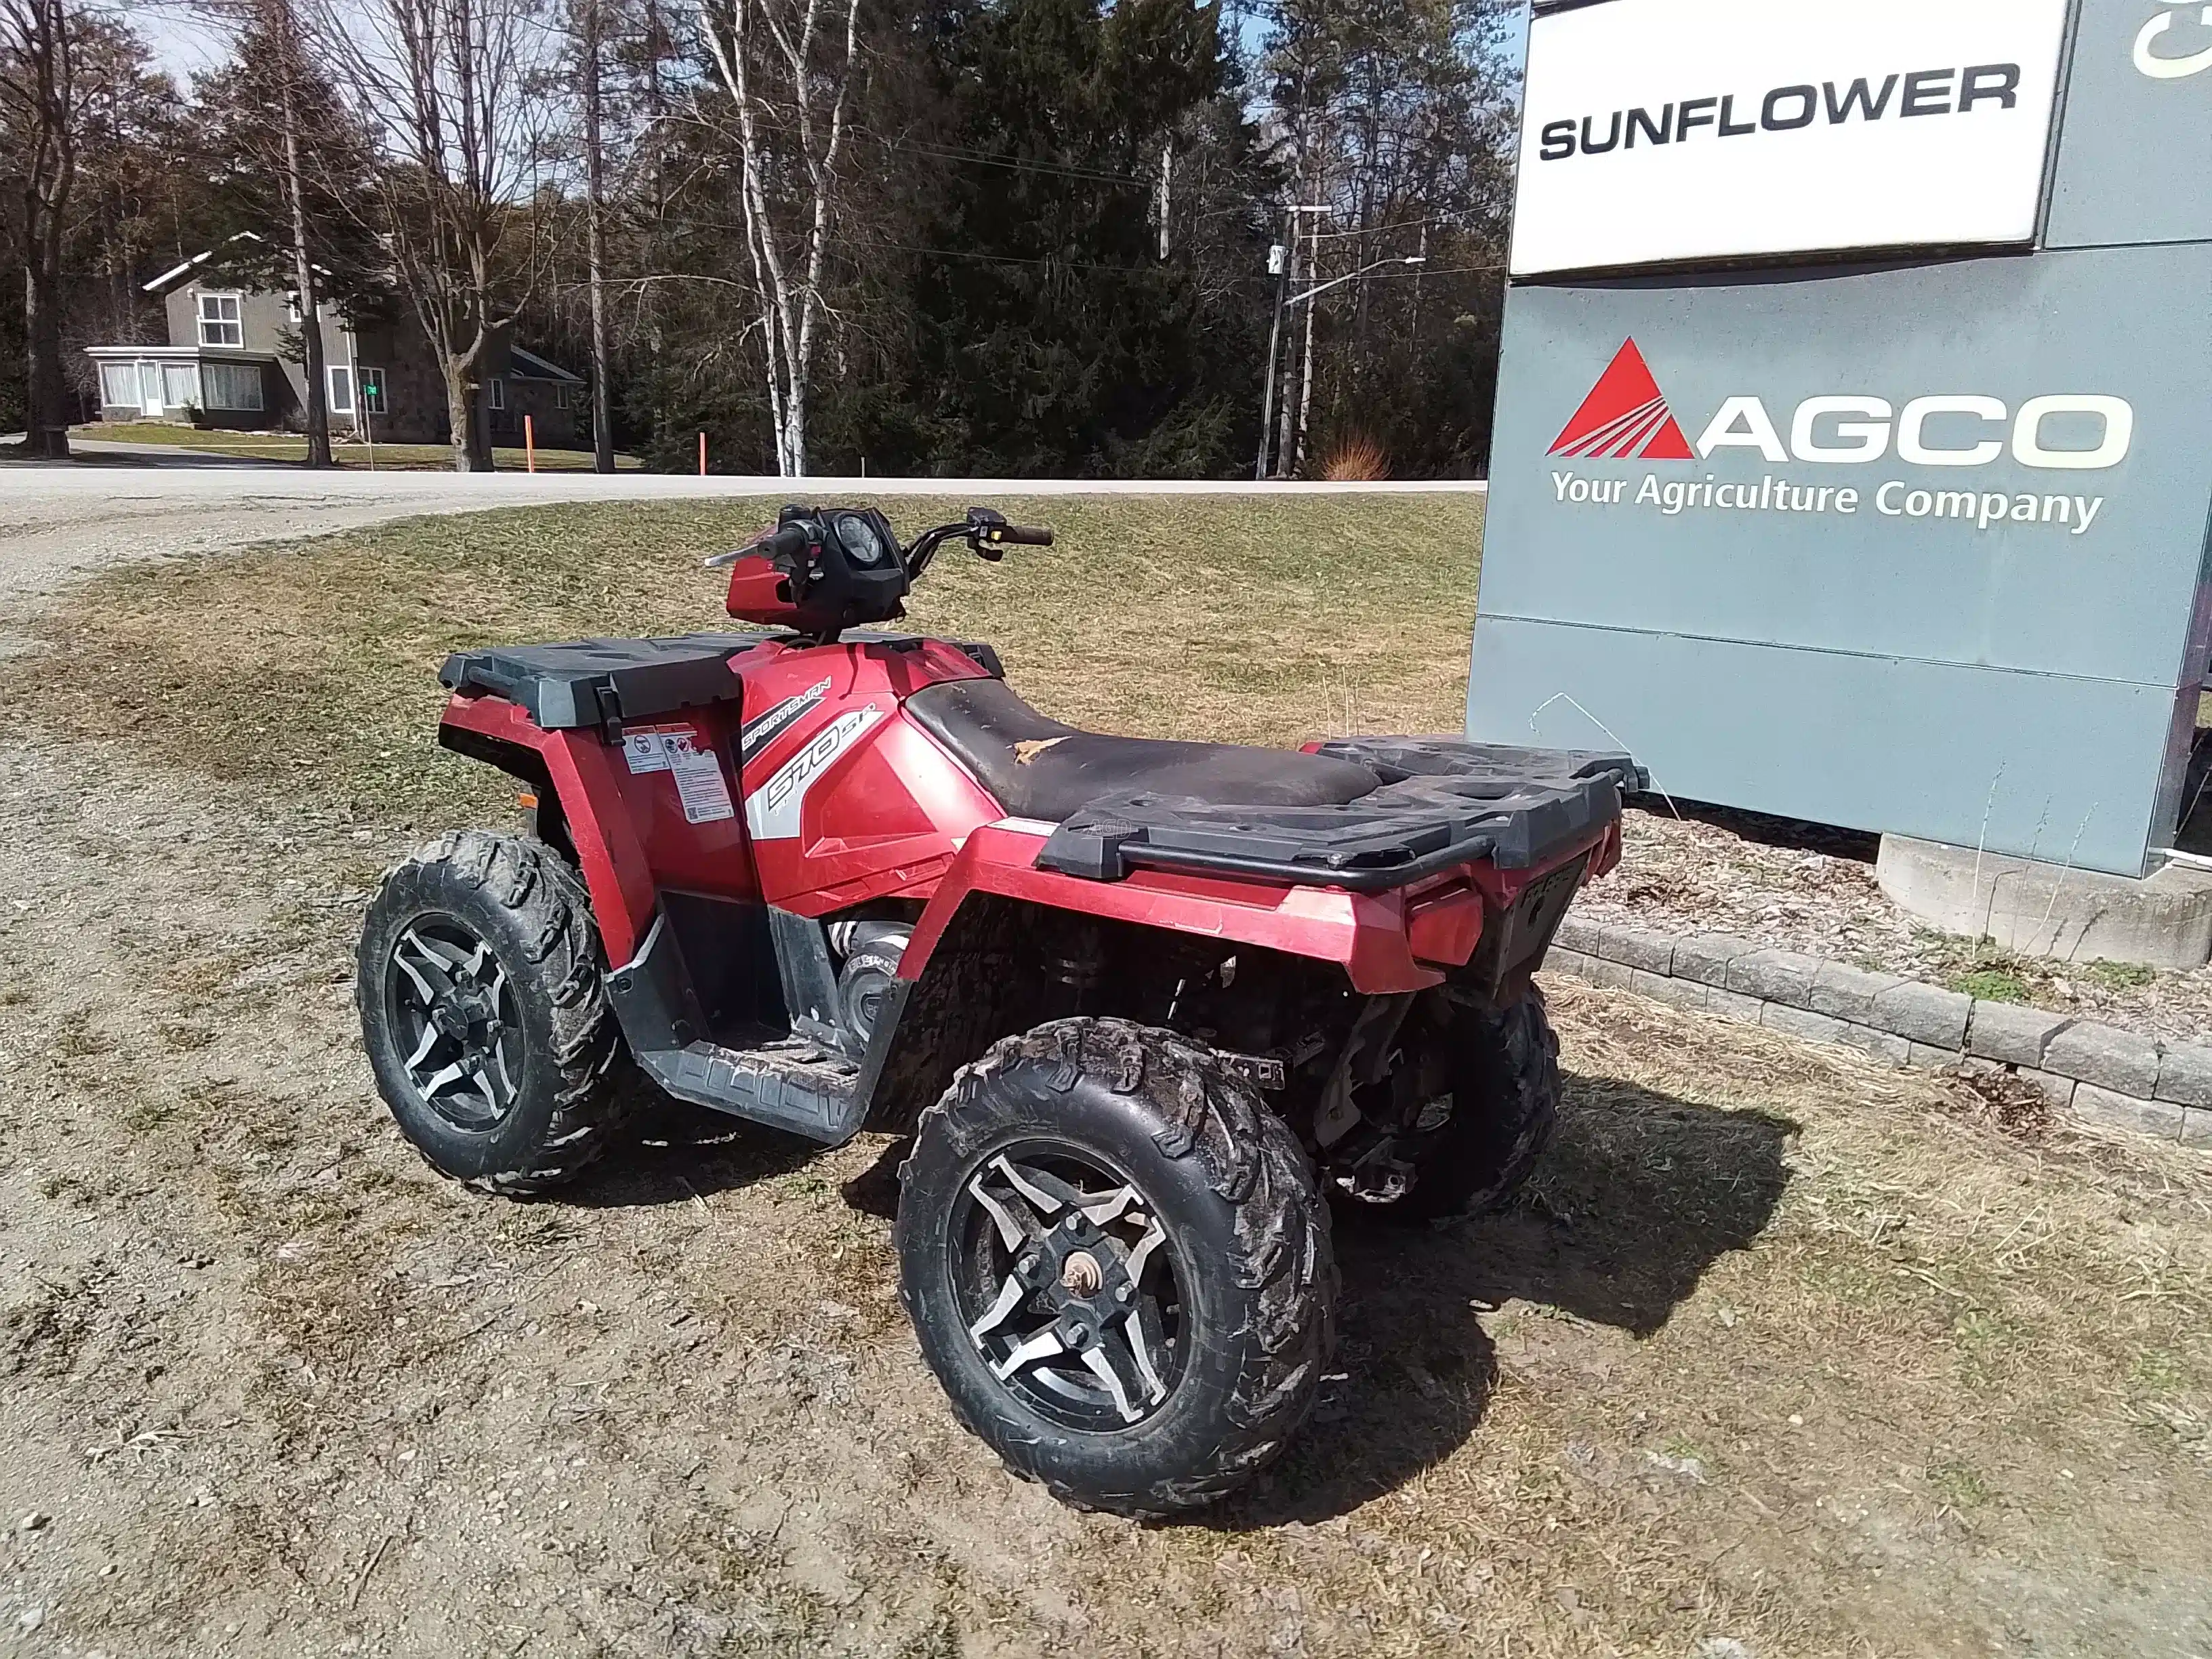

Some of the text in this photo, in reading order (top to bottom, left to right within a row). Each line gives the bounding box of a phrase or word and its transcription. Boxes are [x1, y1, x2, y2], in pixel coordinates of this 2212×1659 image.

[1539, 62, 2022, 161] SUNFLOWER
[1696, 393, 2133, 470] AGCO
[1551, 470, 2104, 534] Your Agriculture Company
[742, 675, 832, 752] SPORTSMAN
[768, 725, 840, 812] 570
